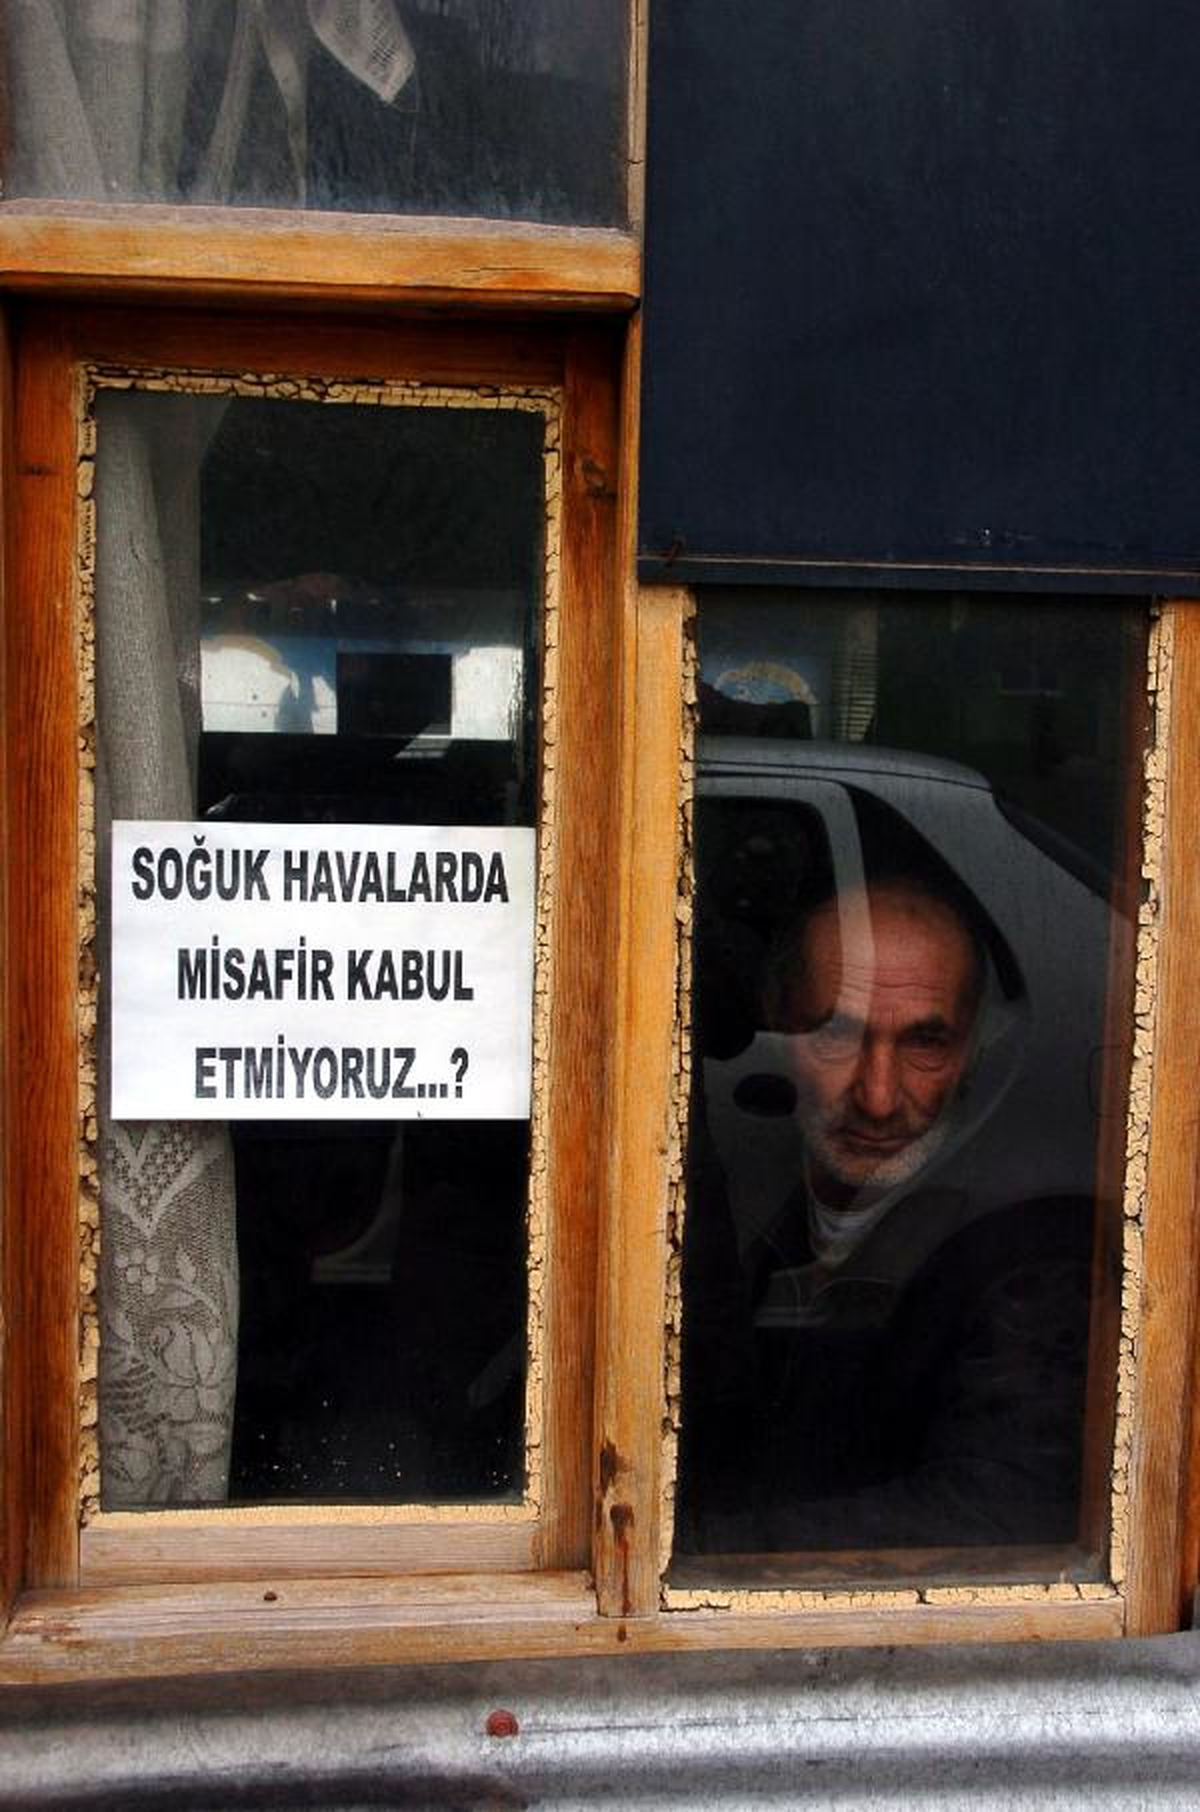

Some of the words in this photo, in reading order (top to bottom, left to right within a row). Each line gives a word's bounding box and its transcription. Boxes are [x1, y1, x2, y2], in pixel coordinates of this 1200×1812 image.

[131, 835, 271, 901] SOĞUK
[283, 850, 509, 903] HAVALARDA
[177, 935, 335, 1001] MİSAFİR
[347, 949, 474, 1001] KABUL
[194, 1034, 469, 1099] ETMİYORUZ...?
